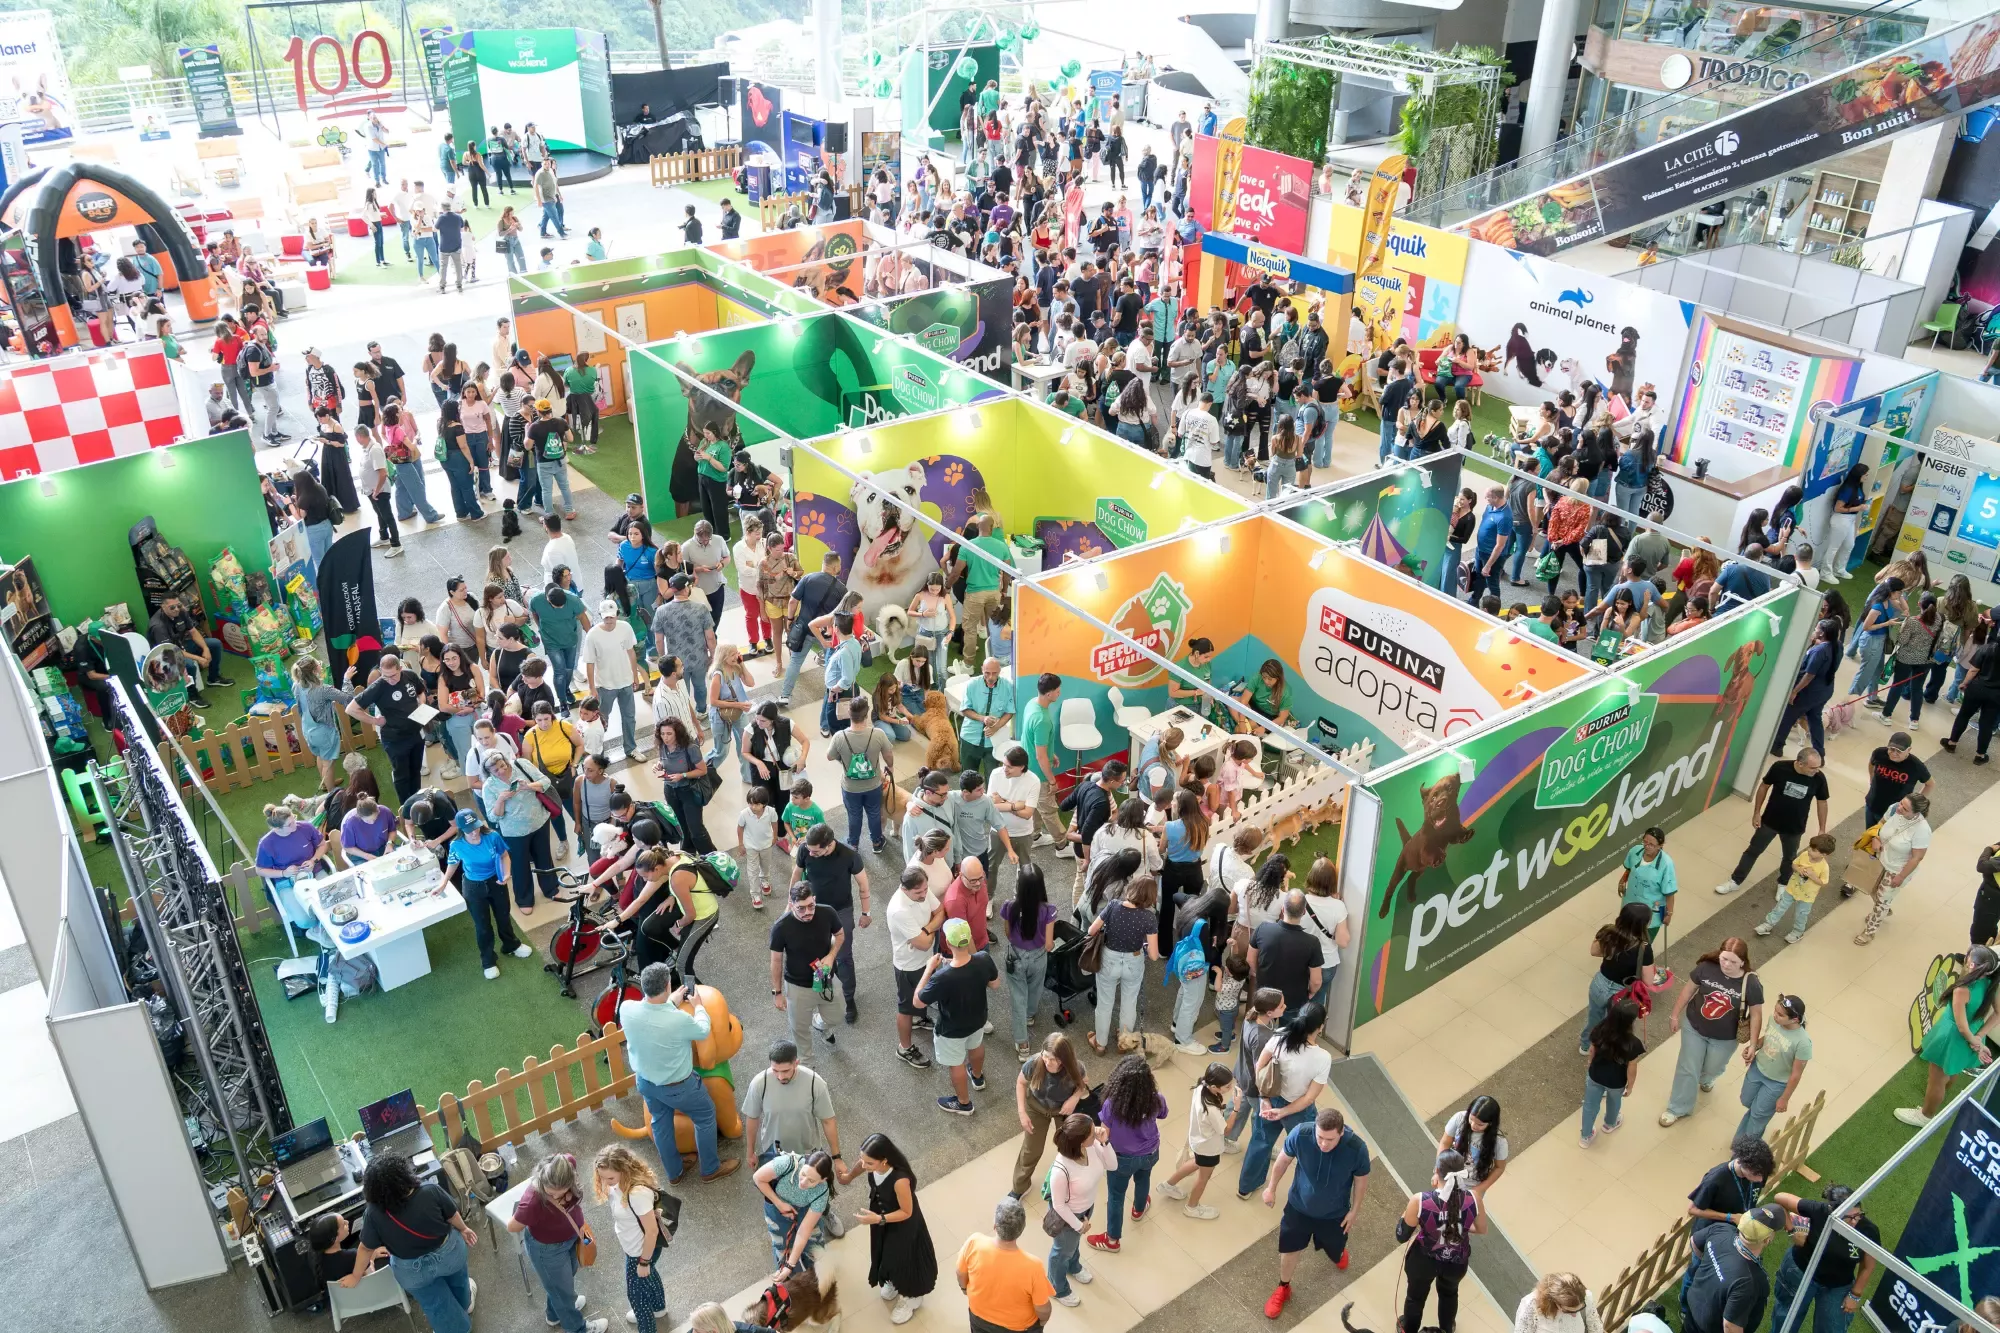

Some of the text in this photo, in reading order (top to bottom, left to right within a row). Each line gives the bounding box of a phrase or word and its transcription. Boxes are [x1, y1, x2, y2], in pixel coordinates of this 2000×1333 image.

[0, 42, 36, 56] lanet
[284, 31, 392, 112] 100
[1841, 107, 1918, 145] Bon nuit!
[1664, 158, 1683, 173] LA
[1684, 142, 1714, 164] CITÉ
[1674, 165, 1732, 190] Estacionamiento
[1740, 152, 1767, 165] terraza
[1767, 131, 1819, 157] gastronómica
[1241, 175, 1265, 188] ave a
[1236, 188, 1278, 220] reak
[1235, 216, 1260, 231] ave a
[1555, 220, 1603, 247] Bonsoir!
[1250, 250, 1287, 273] Nesquik
[1385, 234, 1428, 259] squik
[1530, 301, 1616, 335] animal planet
[895, 375, 911, 396] DOG
[912, 385, 937, 408] CHOW
[1924, 456, 1967, 479] Nestlé
[1641, 500, 1665, 516] usto
[1643, 492, 1668, 510] olce
[1979, 497, 1998, 519] 5
[1097, 506, 1144, 541] DOG CHOW
[342, 582, 355, 631] CORPORACIÓN
[1098, 633, 1158, 664] REFUIO
[1104, 660, 1115, 673] EL
[1315, 646, 1438, 733] adopta
[1588, 706, 1629, 734] PURINA
[1544, 715, 1650, 789] DOG CHOW
[1876, 764, 1909, 782] HUGO
[1404, 720, 1724, 972] pet weekend
[1959, 1130, 1987, 1162] TU
